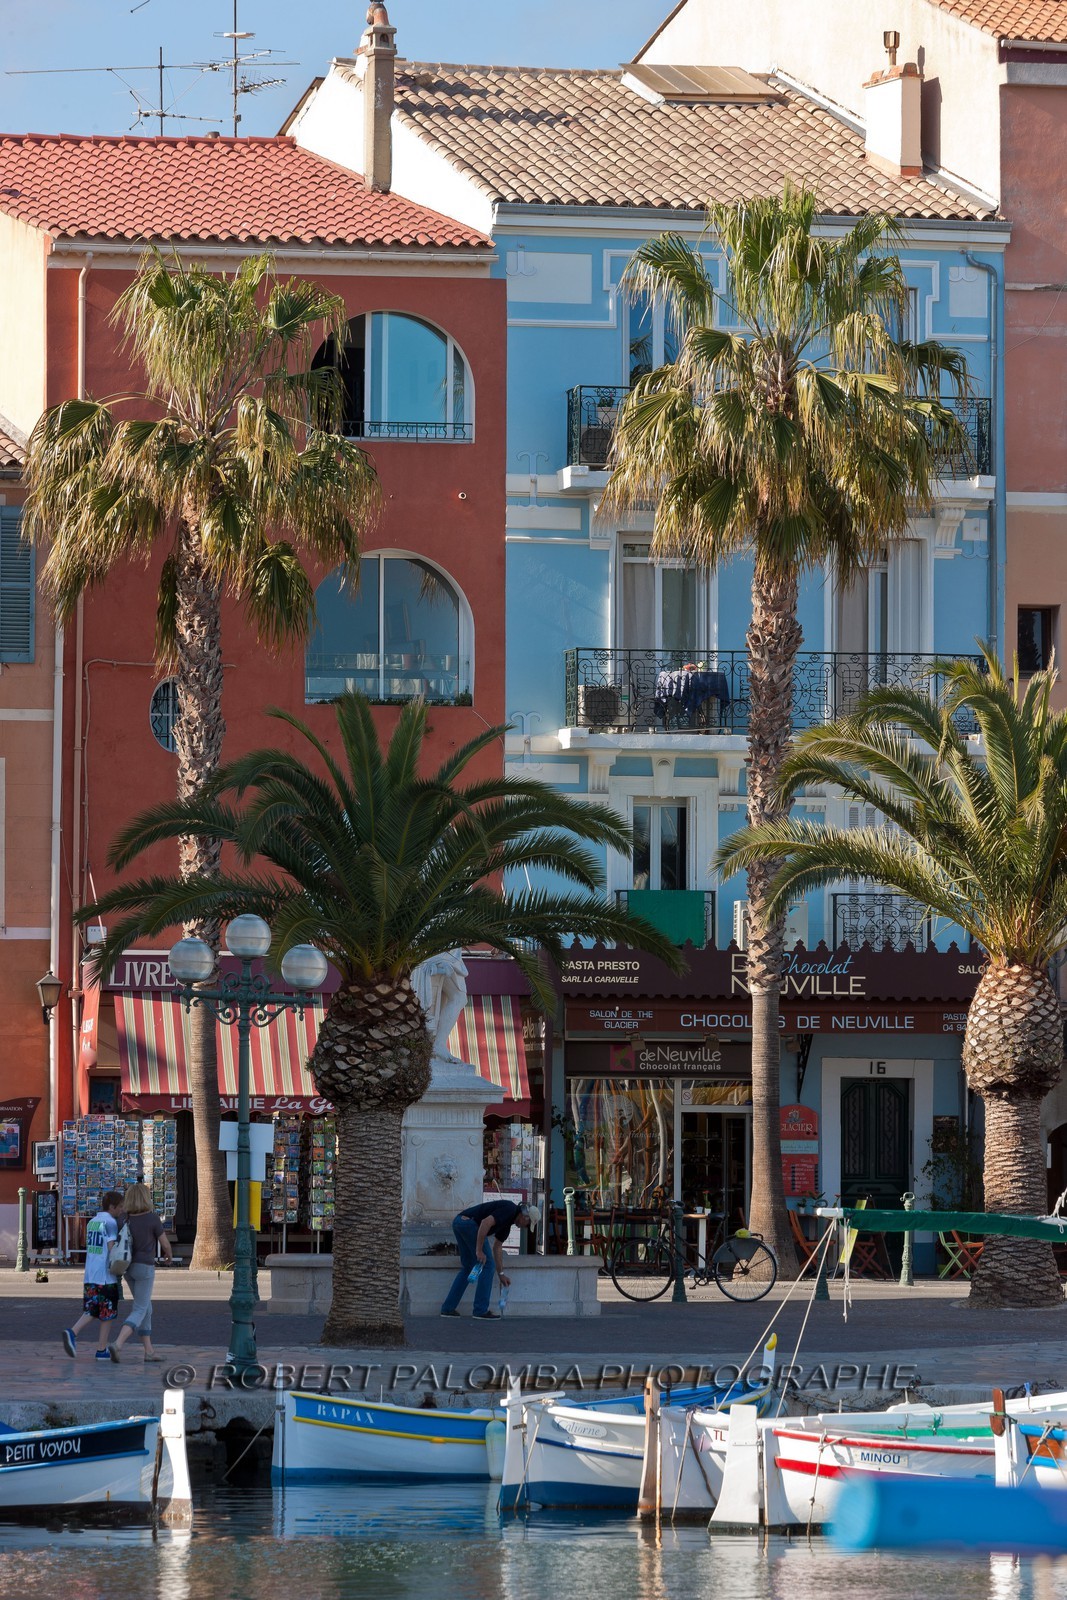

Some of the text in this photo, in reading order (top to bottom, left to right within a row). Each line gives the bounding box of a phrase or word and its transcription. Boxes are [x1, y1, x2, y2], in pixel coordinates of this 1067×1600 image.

[597, 961, 640, 970] PRESTO
[782, 953, 855, 974] Chocolat
[957, 965, 988, 974] SALO
[108, 961, 186, 987] LIVRE
[594, 976, 639, 984] CARAVELLE
[589, 1010, 653, 1018] SALON DE THE
[604, 1021, 639, 1029] GLACIER
[680, 1014, 914, 1029] CHOCOLS DE NEUVILLE
[684, 1063, 722, 1072] français
[869, 1061, 886, 1075] 16
[270, 1096, 303, 1110] La
[317, 1404, 375, 1424] RAPAX
[5, 1443, 35, 1463] PETIT
[860, 1451, 901, 1465] MINOU
